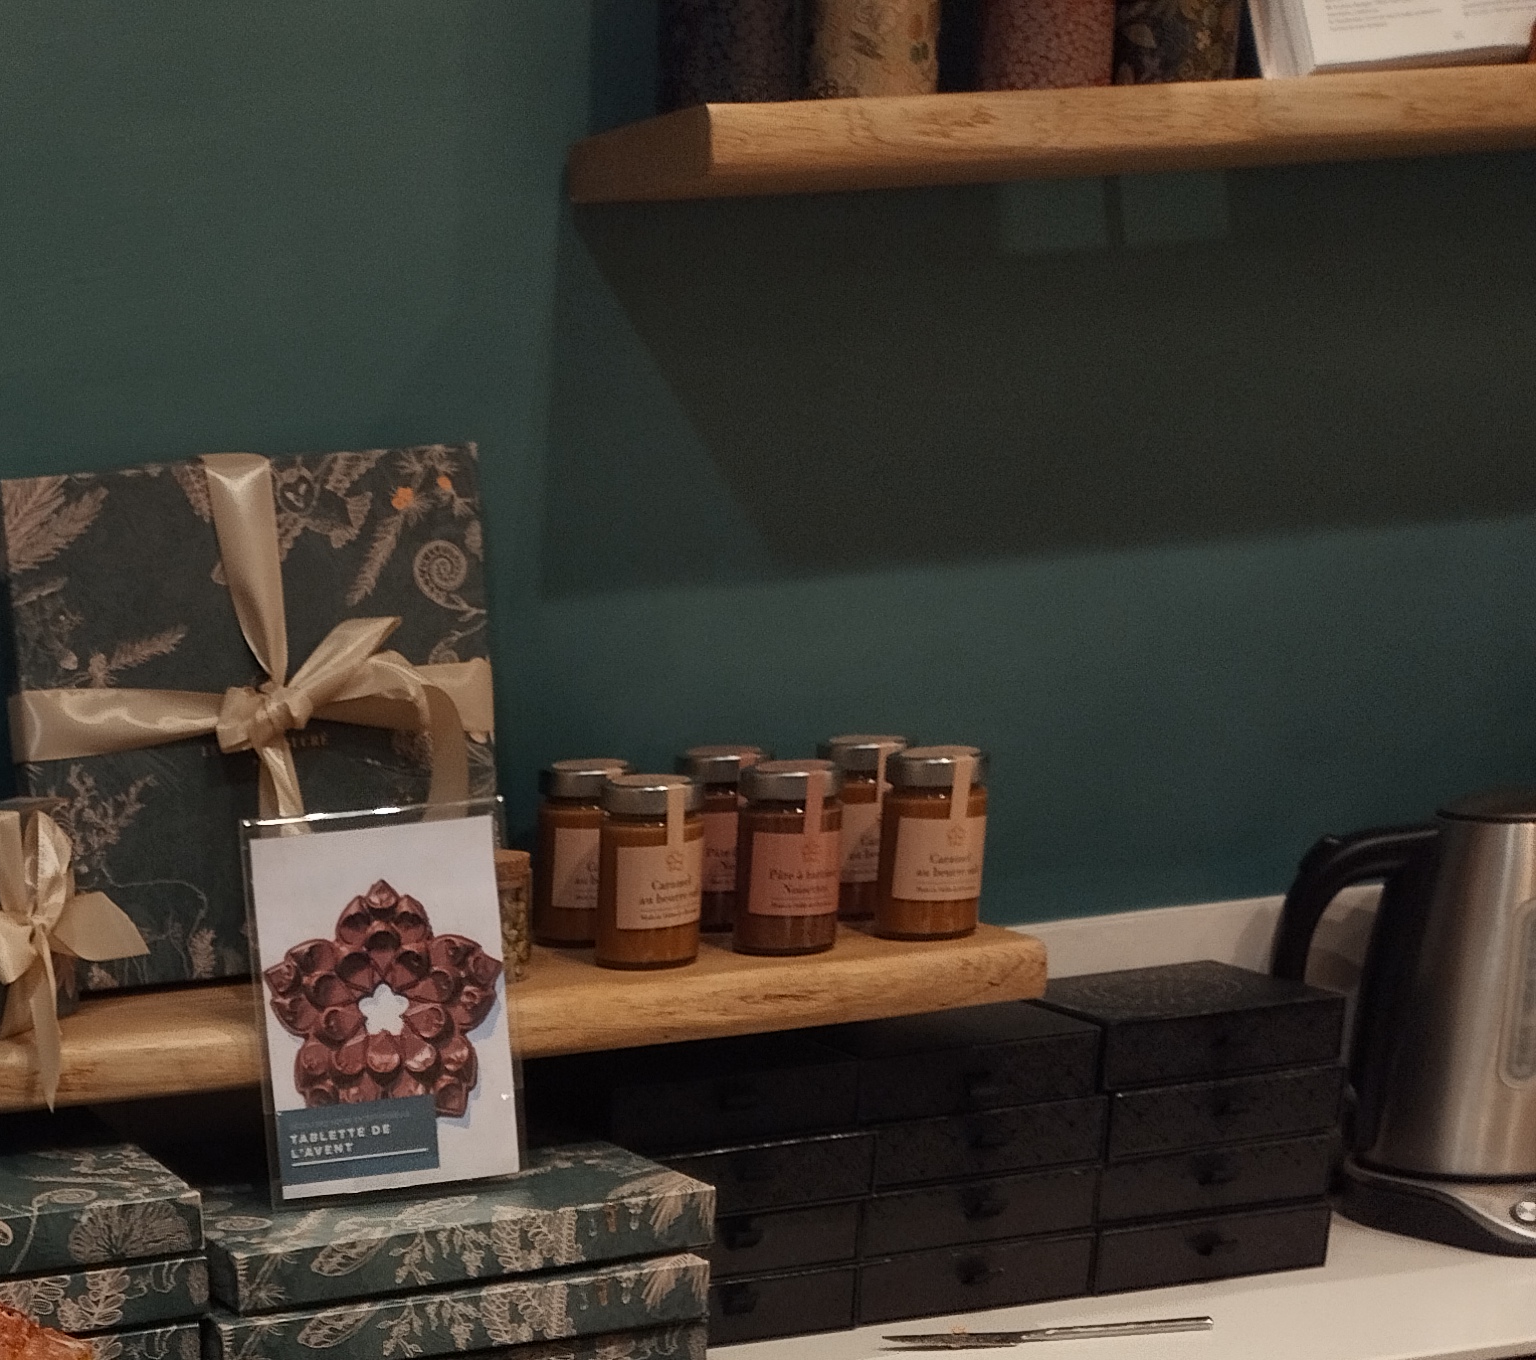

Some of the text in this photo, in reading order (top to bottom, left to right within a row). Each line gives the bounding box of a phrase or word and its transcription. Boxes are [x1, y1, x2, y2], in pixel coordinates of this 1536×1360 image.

[289, 1123, 392, 1145] TABLETTE DE
[290, 1142, 354, 1159] L'AVENT
